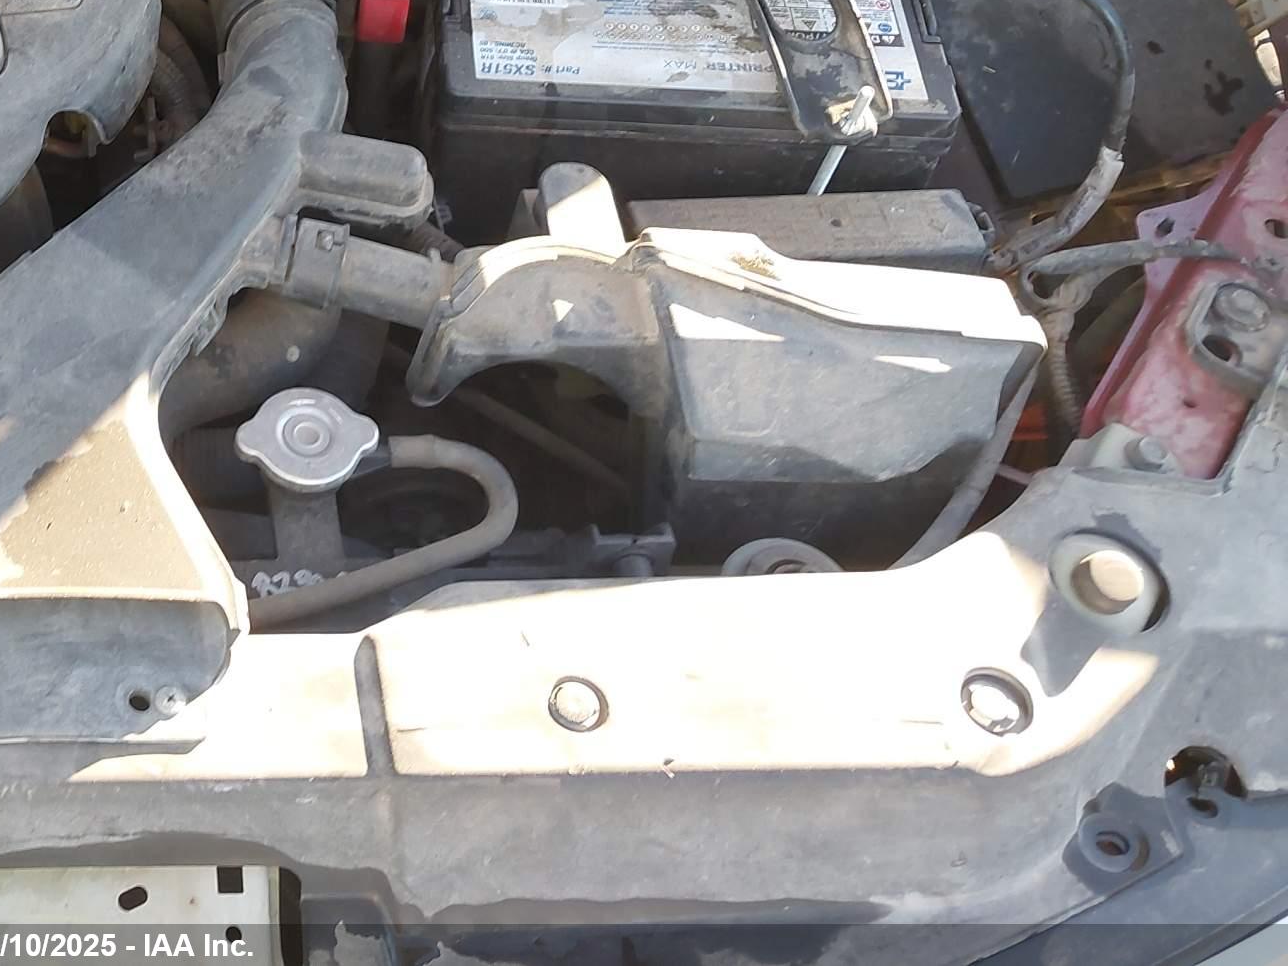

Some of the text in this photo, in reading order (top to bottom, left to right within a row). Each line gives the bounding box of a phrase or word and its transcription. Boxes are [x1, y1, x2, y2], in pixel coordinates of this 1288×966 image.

[481, 62, 536, 76] SX51R
[556, 65, 581, 75] Part
[663, 59, 774, 73] PRINTER MAX
